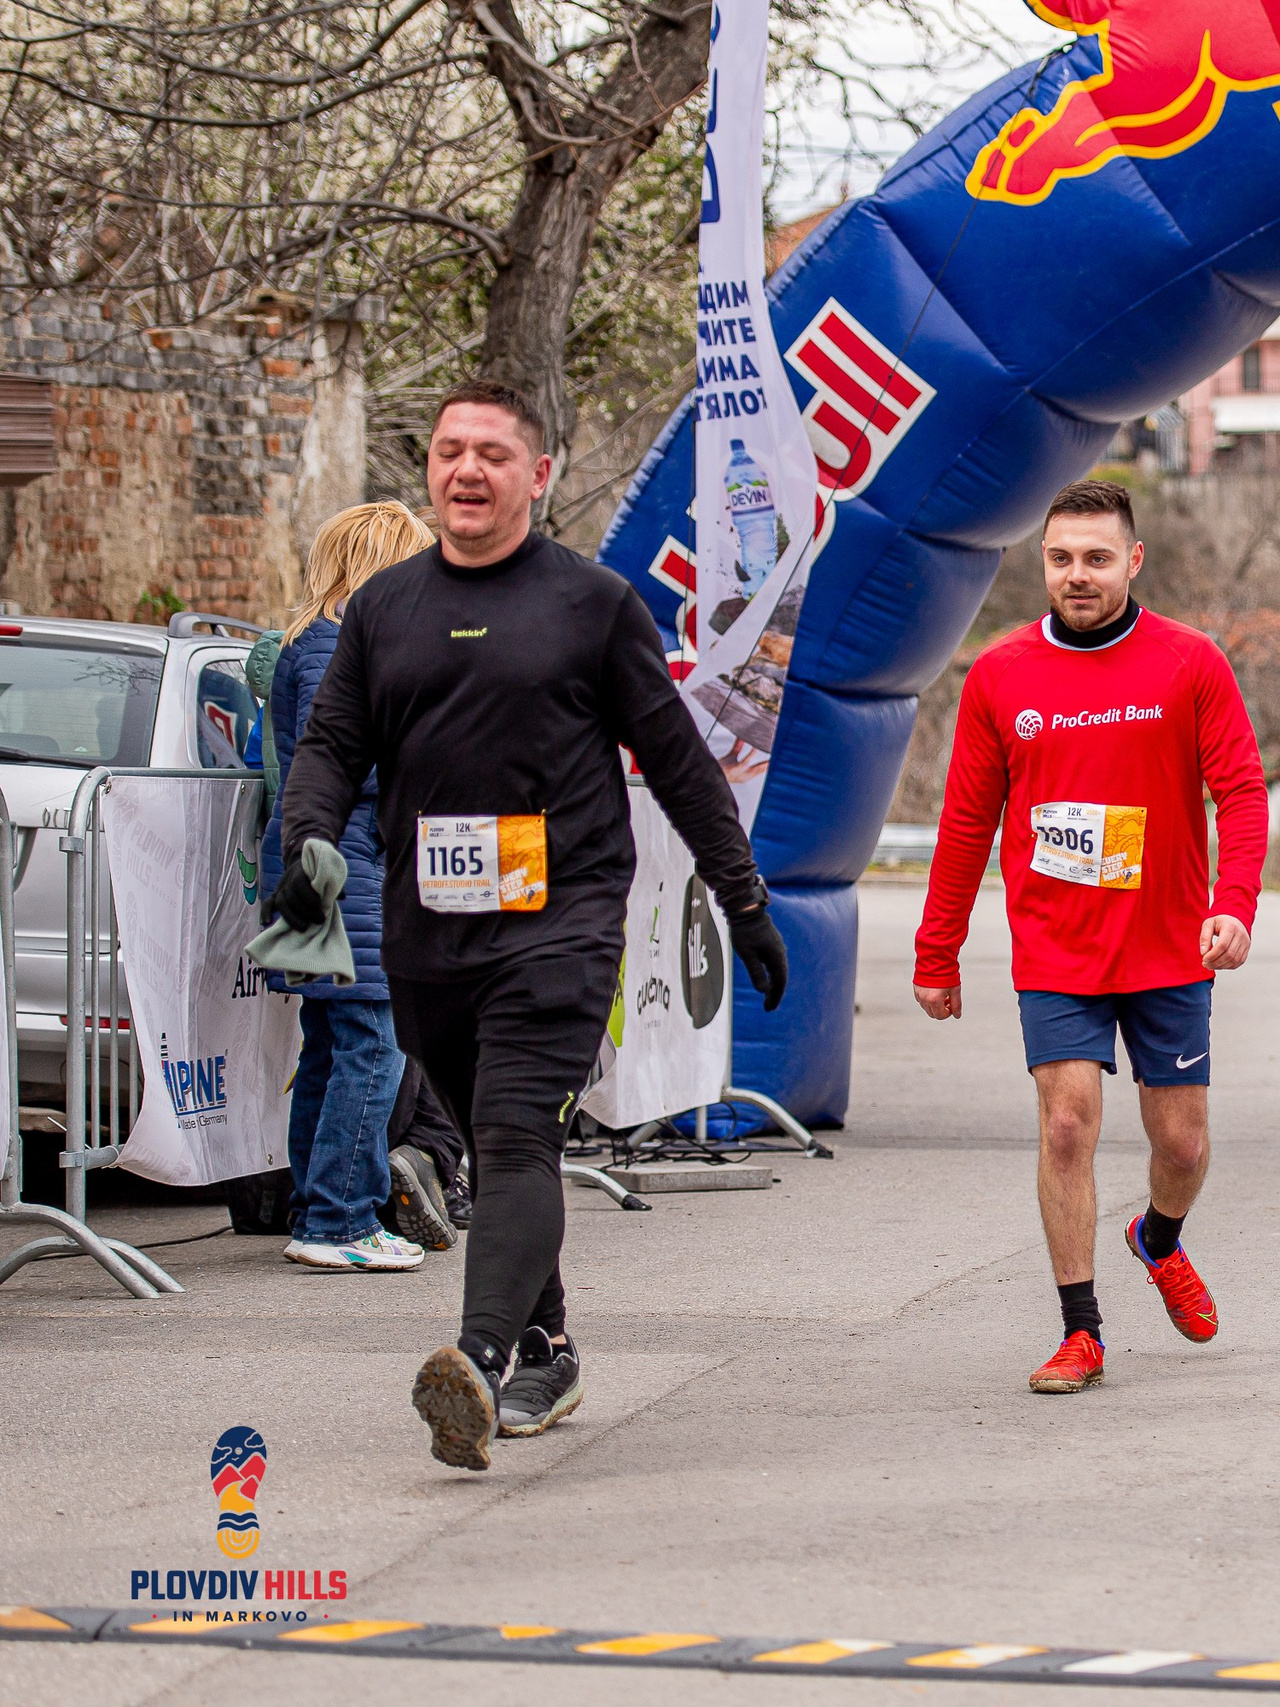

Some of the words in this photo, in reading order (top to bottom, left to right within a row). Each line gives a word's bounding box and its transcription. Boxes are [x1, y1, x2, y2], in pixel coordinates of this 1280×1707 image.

[698, 280, 750, 314] ДИМ
[731, 490, 767, 506] DEVIN
[1051, 708, 1121, 730] ProCredit
[1124, 704, 1163, 721] Bank
[1067, 807, 1082, 816] 12K
[455, 822, 471, 833] 12K
[1037, 826, 1094, 855] 1306
[427, 846, 484, 876] 1165
